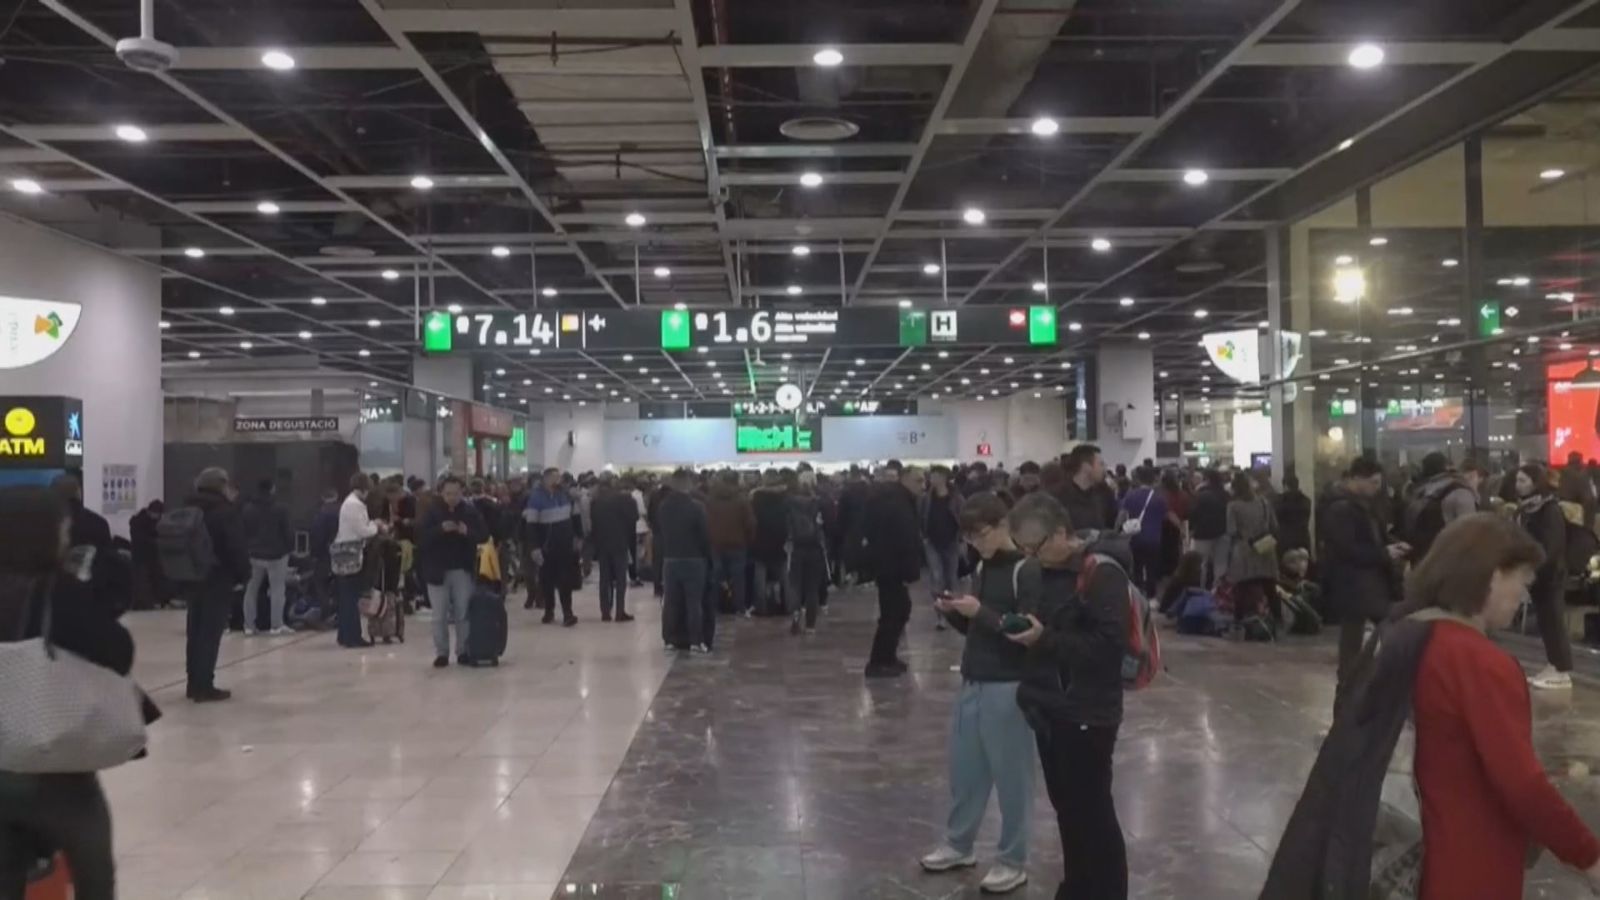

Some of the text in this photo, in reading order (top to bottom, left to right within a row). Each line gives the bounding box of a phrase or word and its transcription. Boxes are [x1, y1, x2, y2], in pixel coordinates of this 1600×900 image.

[235, 419, 337, 430] ZONA DEGUSTACIÓ
[0, 437, 45, 455] ATM
